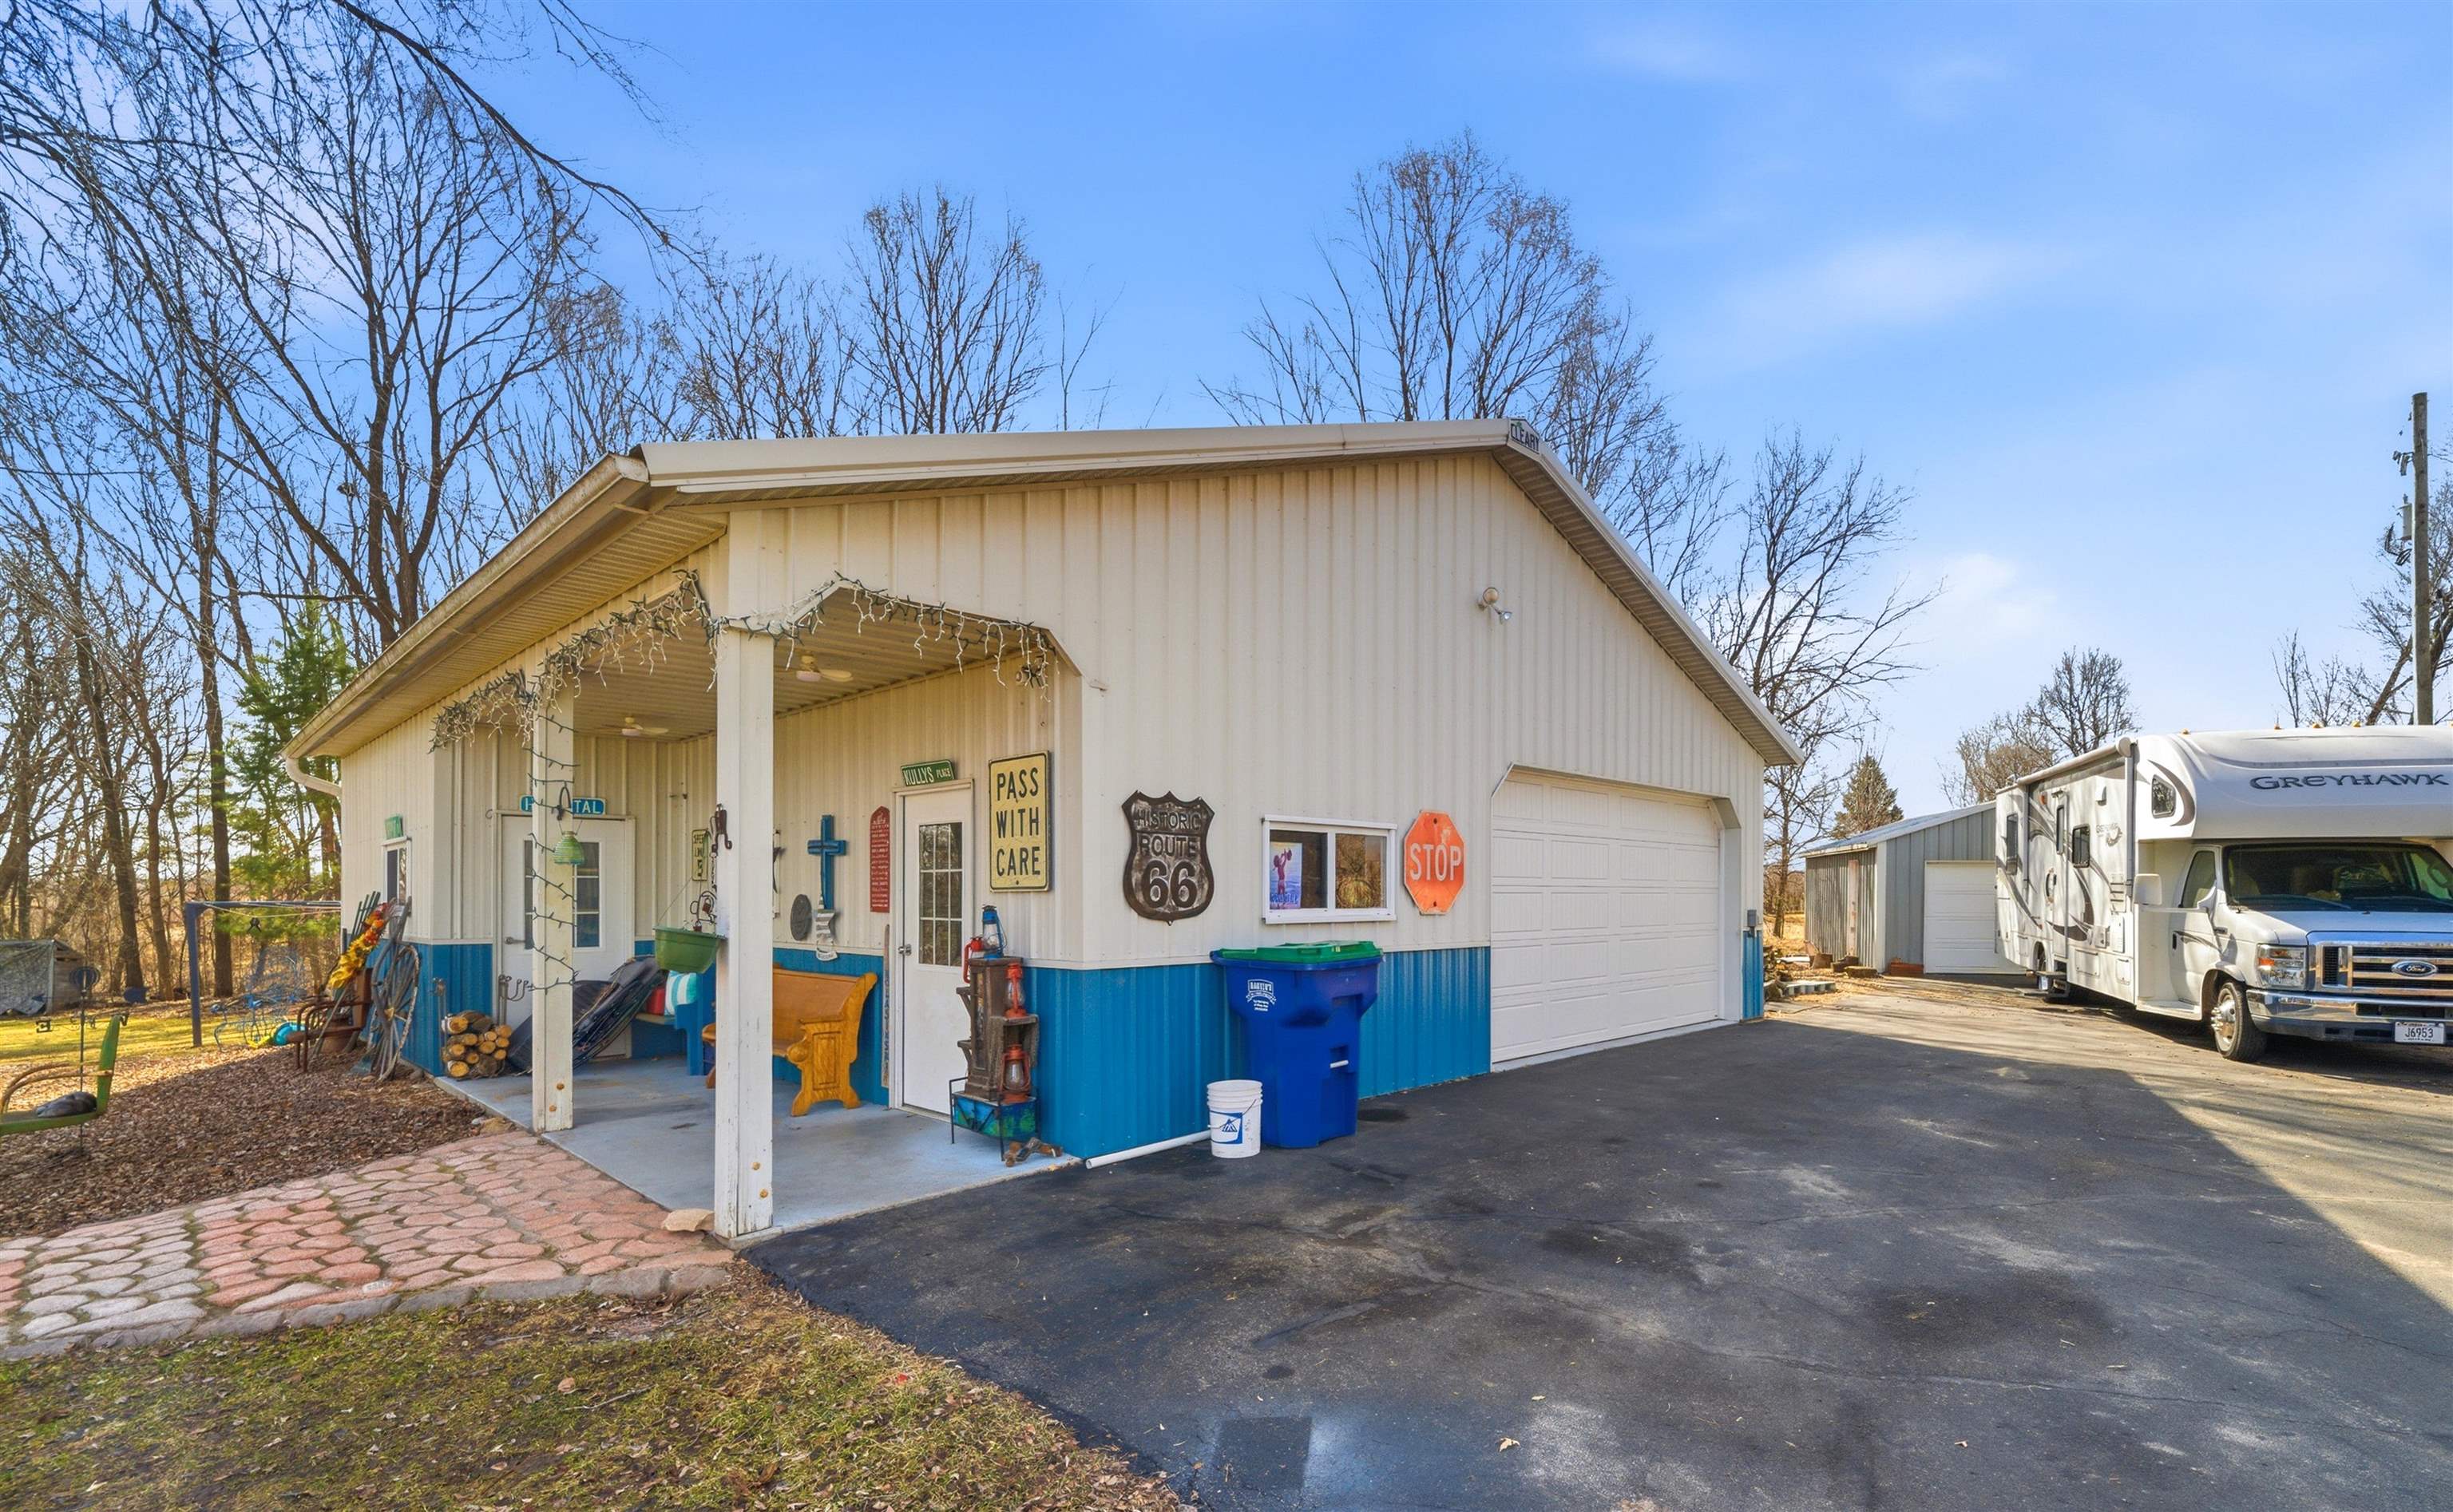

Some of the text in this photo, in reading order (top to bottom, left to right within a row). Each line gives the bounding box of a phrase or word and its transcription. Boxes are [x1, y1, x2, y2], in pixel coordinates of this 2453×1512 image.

[903, 766, 934, 786] KULLYS
[997, 767, 1038, 801] PASS
[2249, 774, 2449, 790] GREYHAWK
[997, 807, 1039, 838] WITH
[1136, 809, 1202, 830] HISTORIC
[1139, 835, 1198, 857] ROUTE
[997, 846, 1040, 877] CARE
[1410, 843, 1462, 881] STOP
[1142, 859, 1197, 908] 66
[2404, 1027, 2434, 1038] J6953
